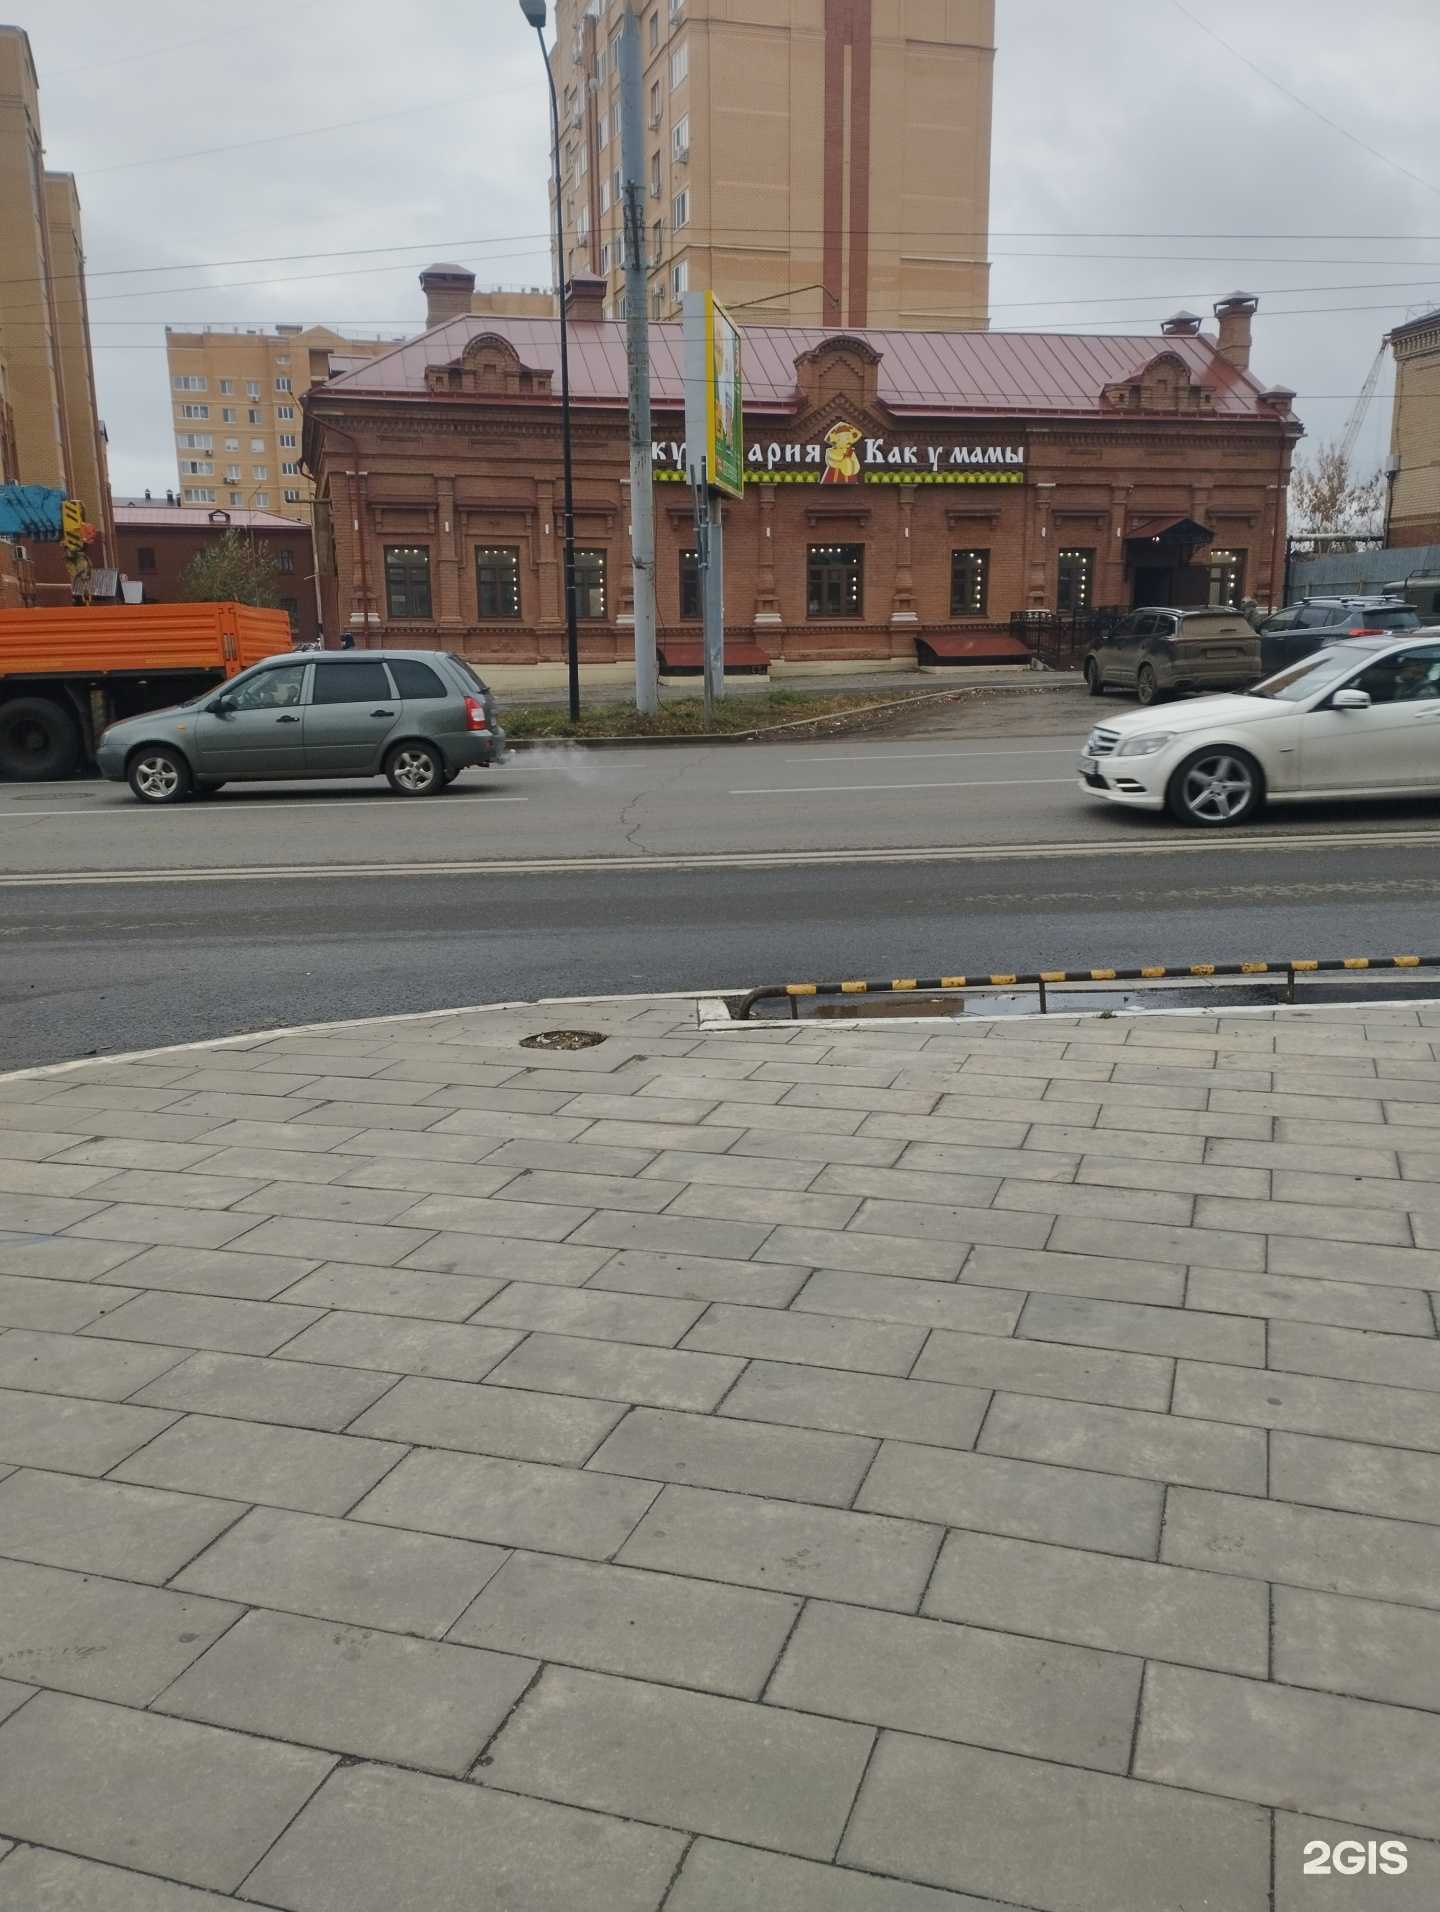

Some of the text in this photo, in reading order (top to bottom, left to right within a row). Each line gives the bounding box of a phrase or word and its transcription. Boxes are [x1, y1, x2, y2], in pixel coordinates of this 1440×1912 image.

[651, 441, 821, 470] куария
[864, 438, 918, 463] Как
[927, 446, 943, 472] у
[950, 446, 1024, 463] мамы
